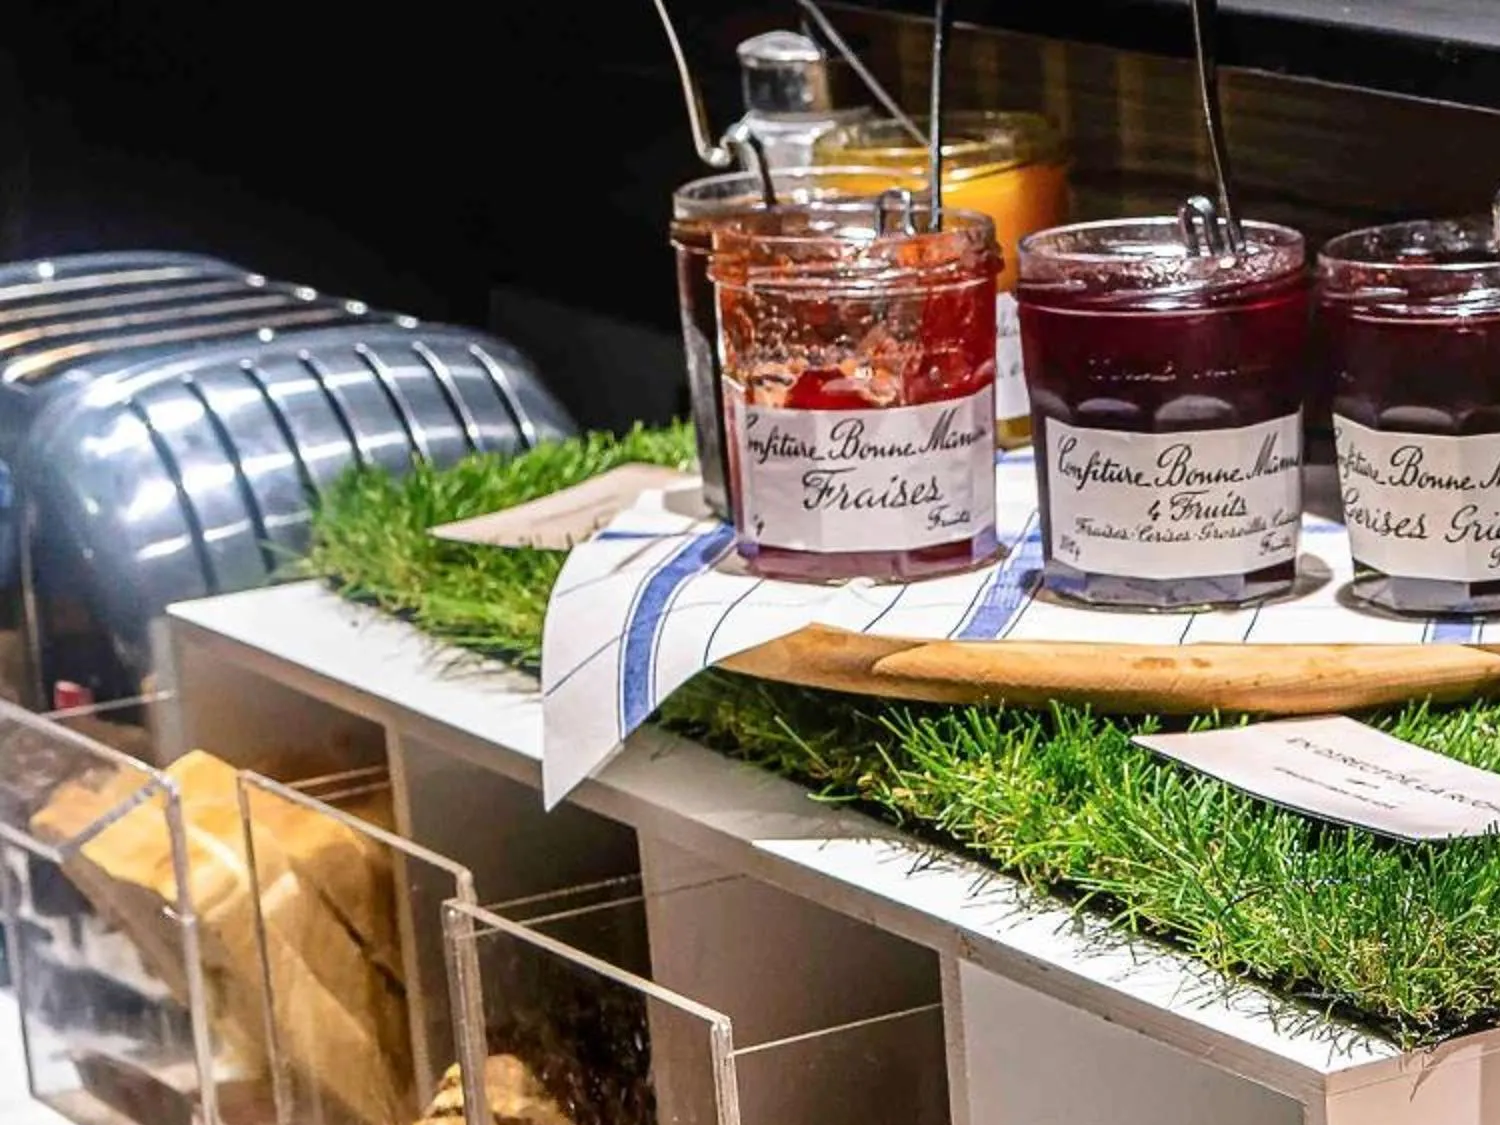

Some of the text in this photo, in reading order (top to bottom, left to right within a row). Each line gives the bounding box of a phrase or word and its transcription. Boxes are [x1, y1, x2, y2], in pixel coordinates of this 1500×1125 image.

[828, 417, 916, 461] Bonne
[1056, 434, 1152, 490] Confiture
[1154, 443, 1244, 489] Bonne
[1384, 444, 1476, 491] Bonne
[802, 466, 945, 511] Fraises
[1147, 500, 1162, 521] 4
[1170, 490, 1249, 522] Fruits
